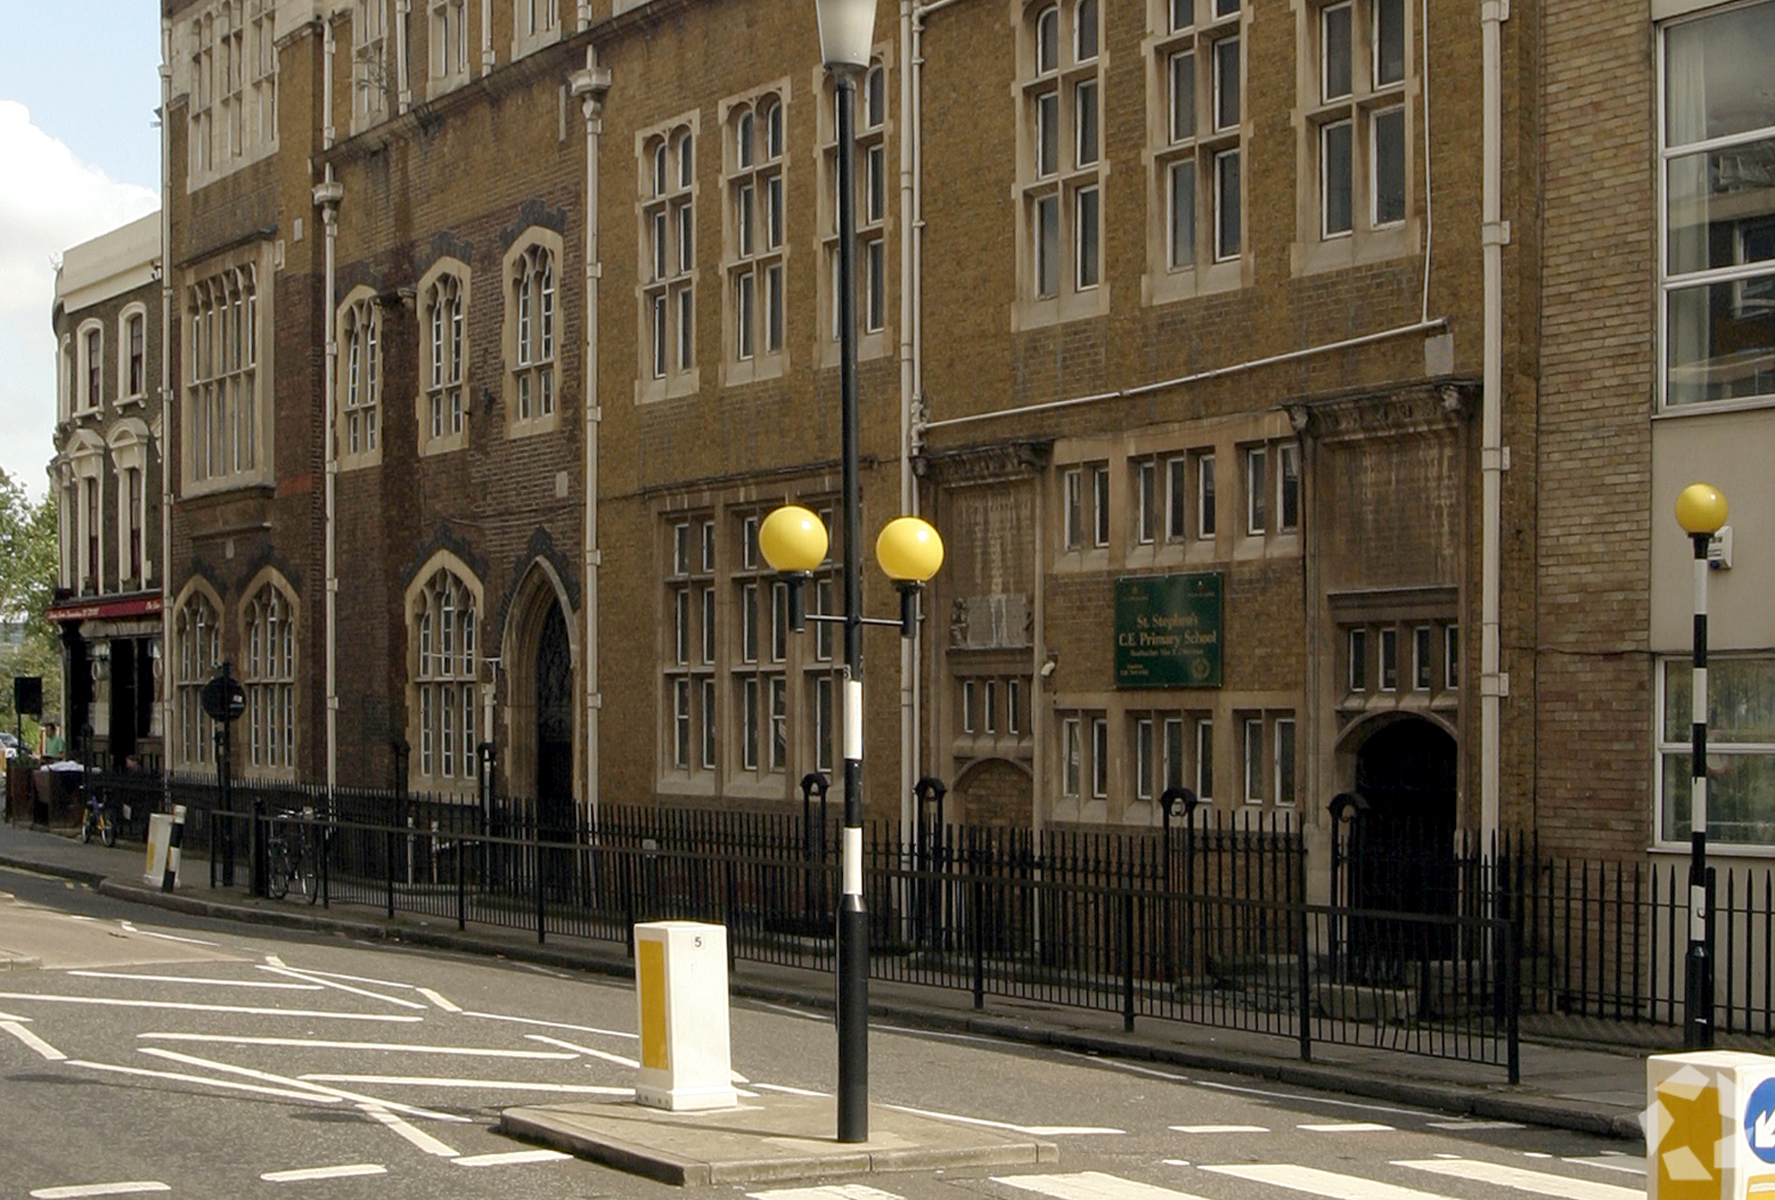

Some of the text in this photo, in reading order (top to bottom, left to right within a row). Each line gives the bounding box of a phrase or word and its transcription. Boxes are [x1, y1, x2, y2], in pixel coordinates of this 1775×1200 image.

[1139, 632, 1181, 649] Primary
[1184, 629, 1218, 645] School
[694, 936, 702, 948] 5
